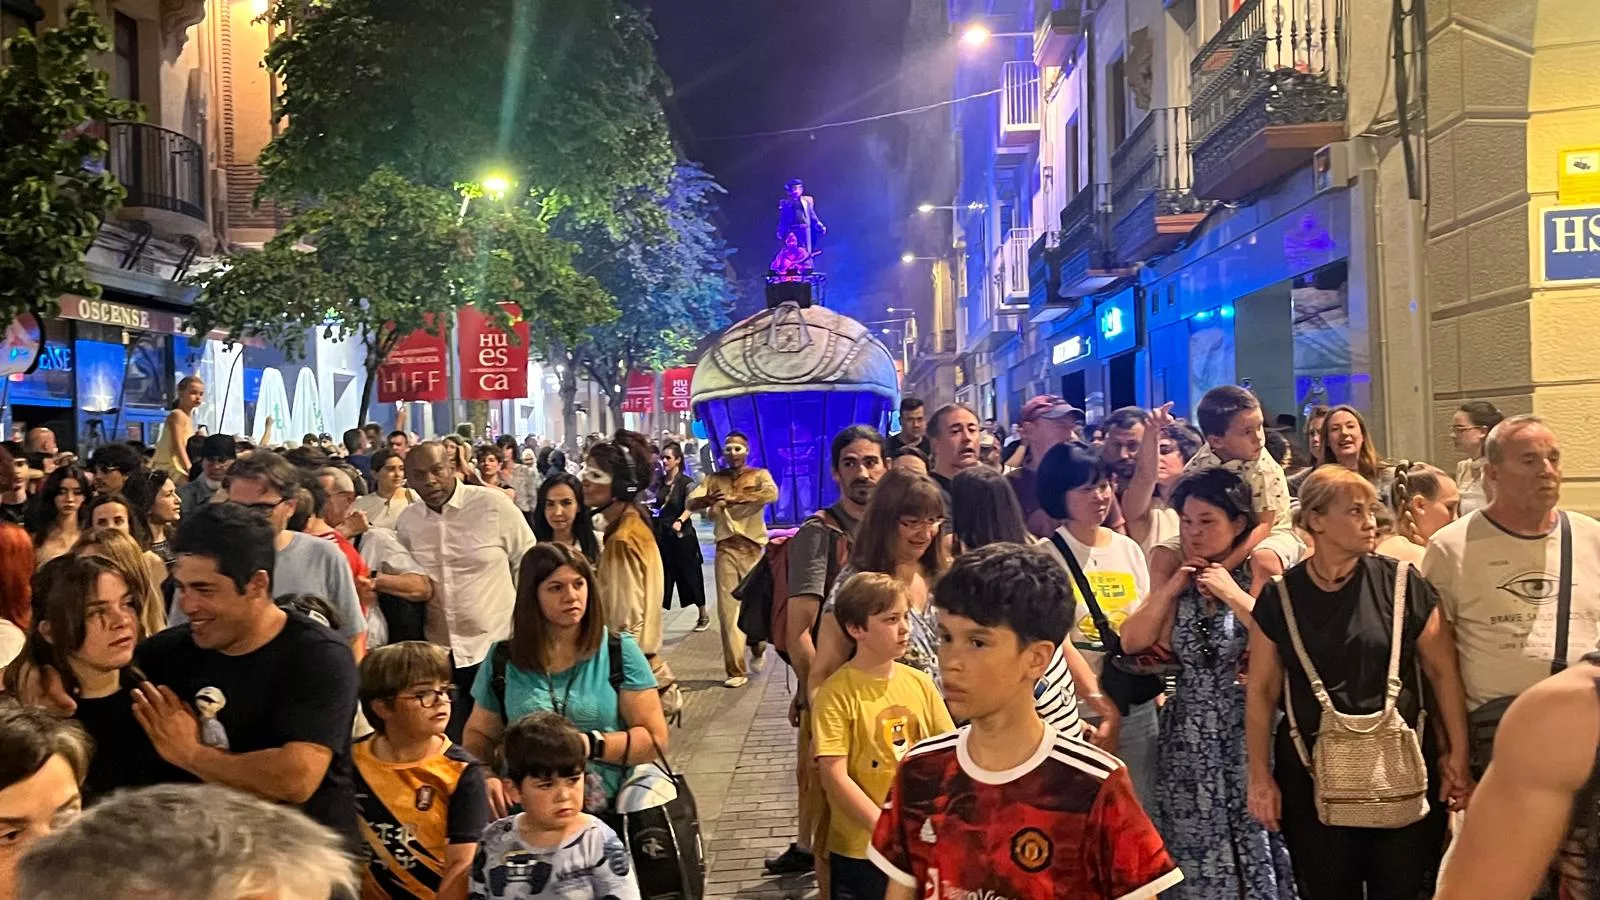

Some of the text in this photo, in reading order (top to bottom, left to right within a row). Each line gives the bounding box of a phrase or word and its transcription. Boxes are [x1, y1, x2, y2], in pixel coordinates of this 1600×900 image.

[79, 299, 150, 328] OSCENSE
[479, 348, 508, 366] es
[382, 370, 440, 393] HIFF
[479, 373, 510, 391] ca
[1490, 613, 1522, 625] BRAVE
